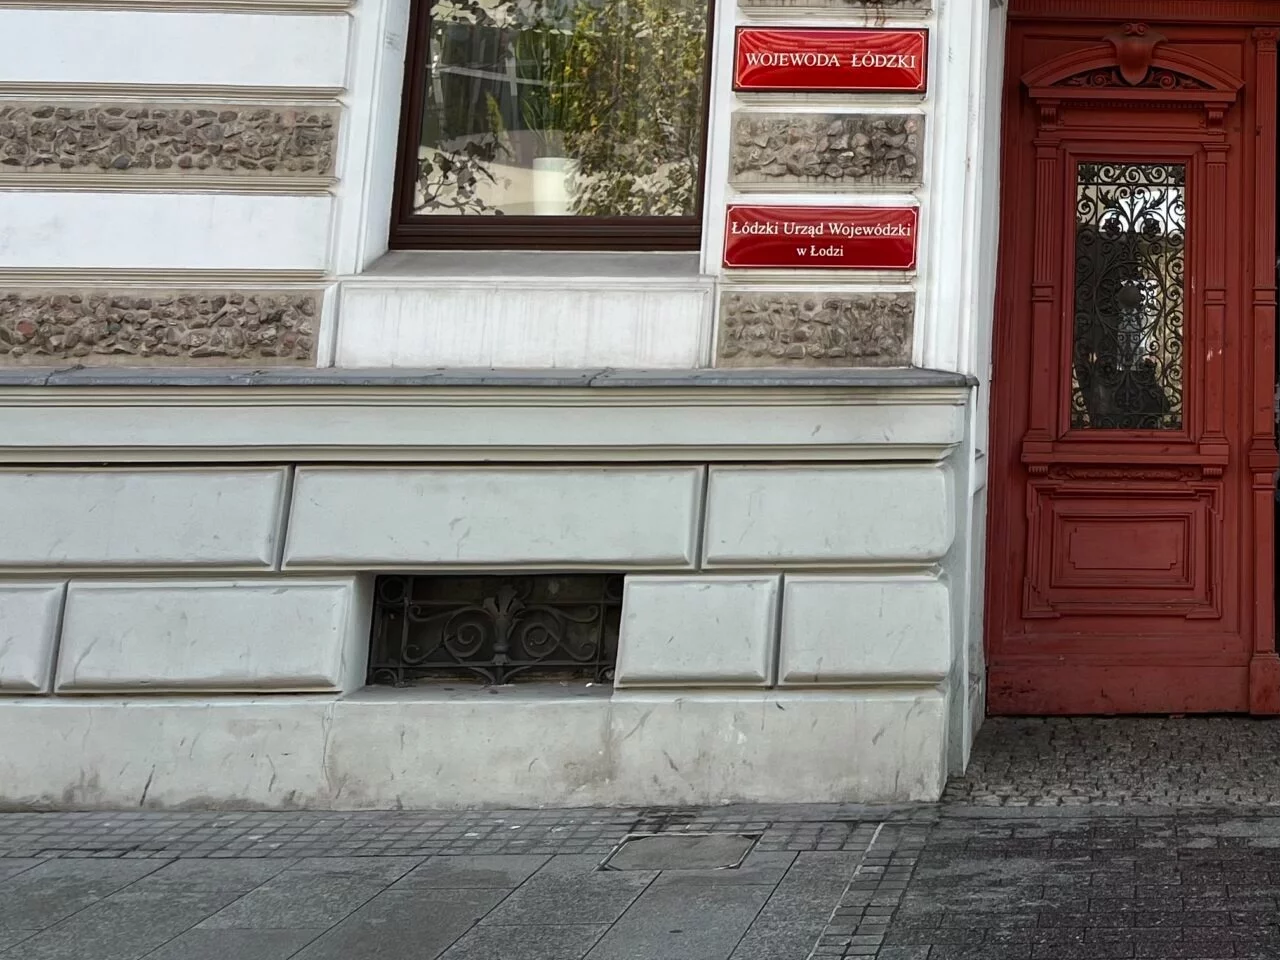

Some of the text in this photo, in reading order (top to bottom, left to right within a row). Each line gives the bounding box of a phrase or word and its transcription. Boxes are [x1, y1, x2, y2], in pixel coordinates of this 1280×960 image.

[745, 51, 916, 68] WOJEWODA ŁÓDZKI
[731, 221, 911, 238] Łódzki Urząd Wojewódzki
[797, 245, 844, 257] w Łodzi
